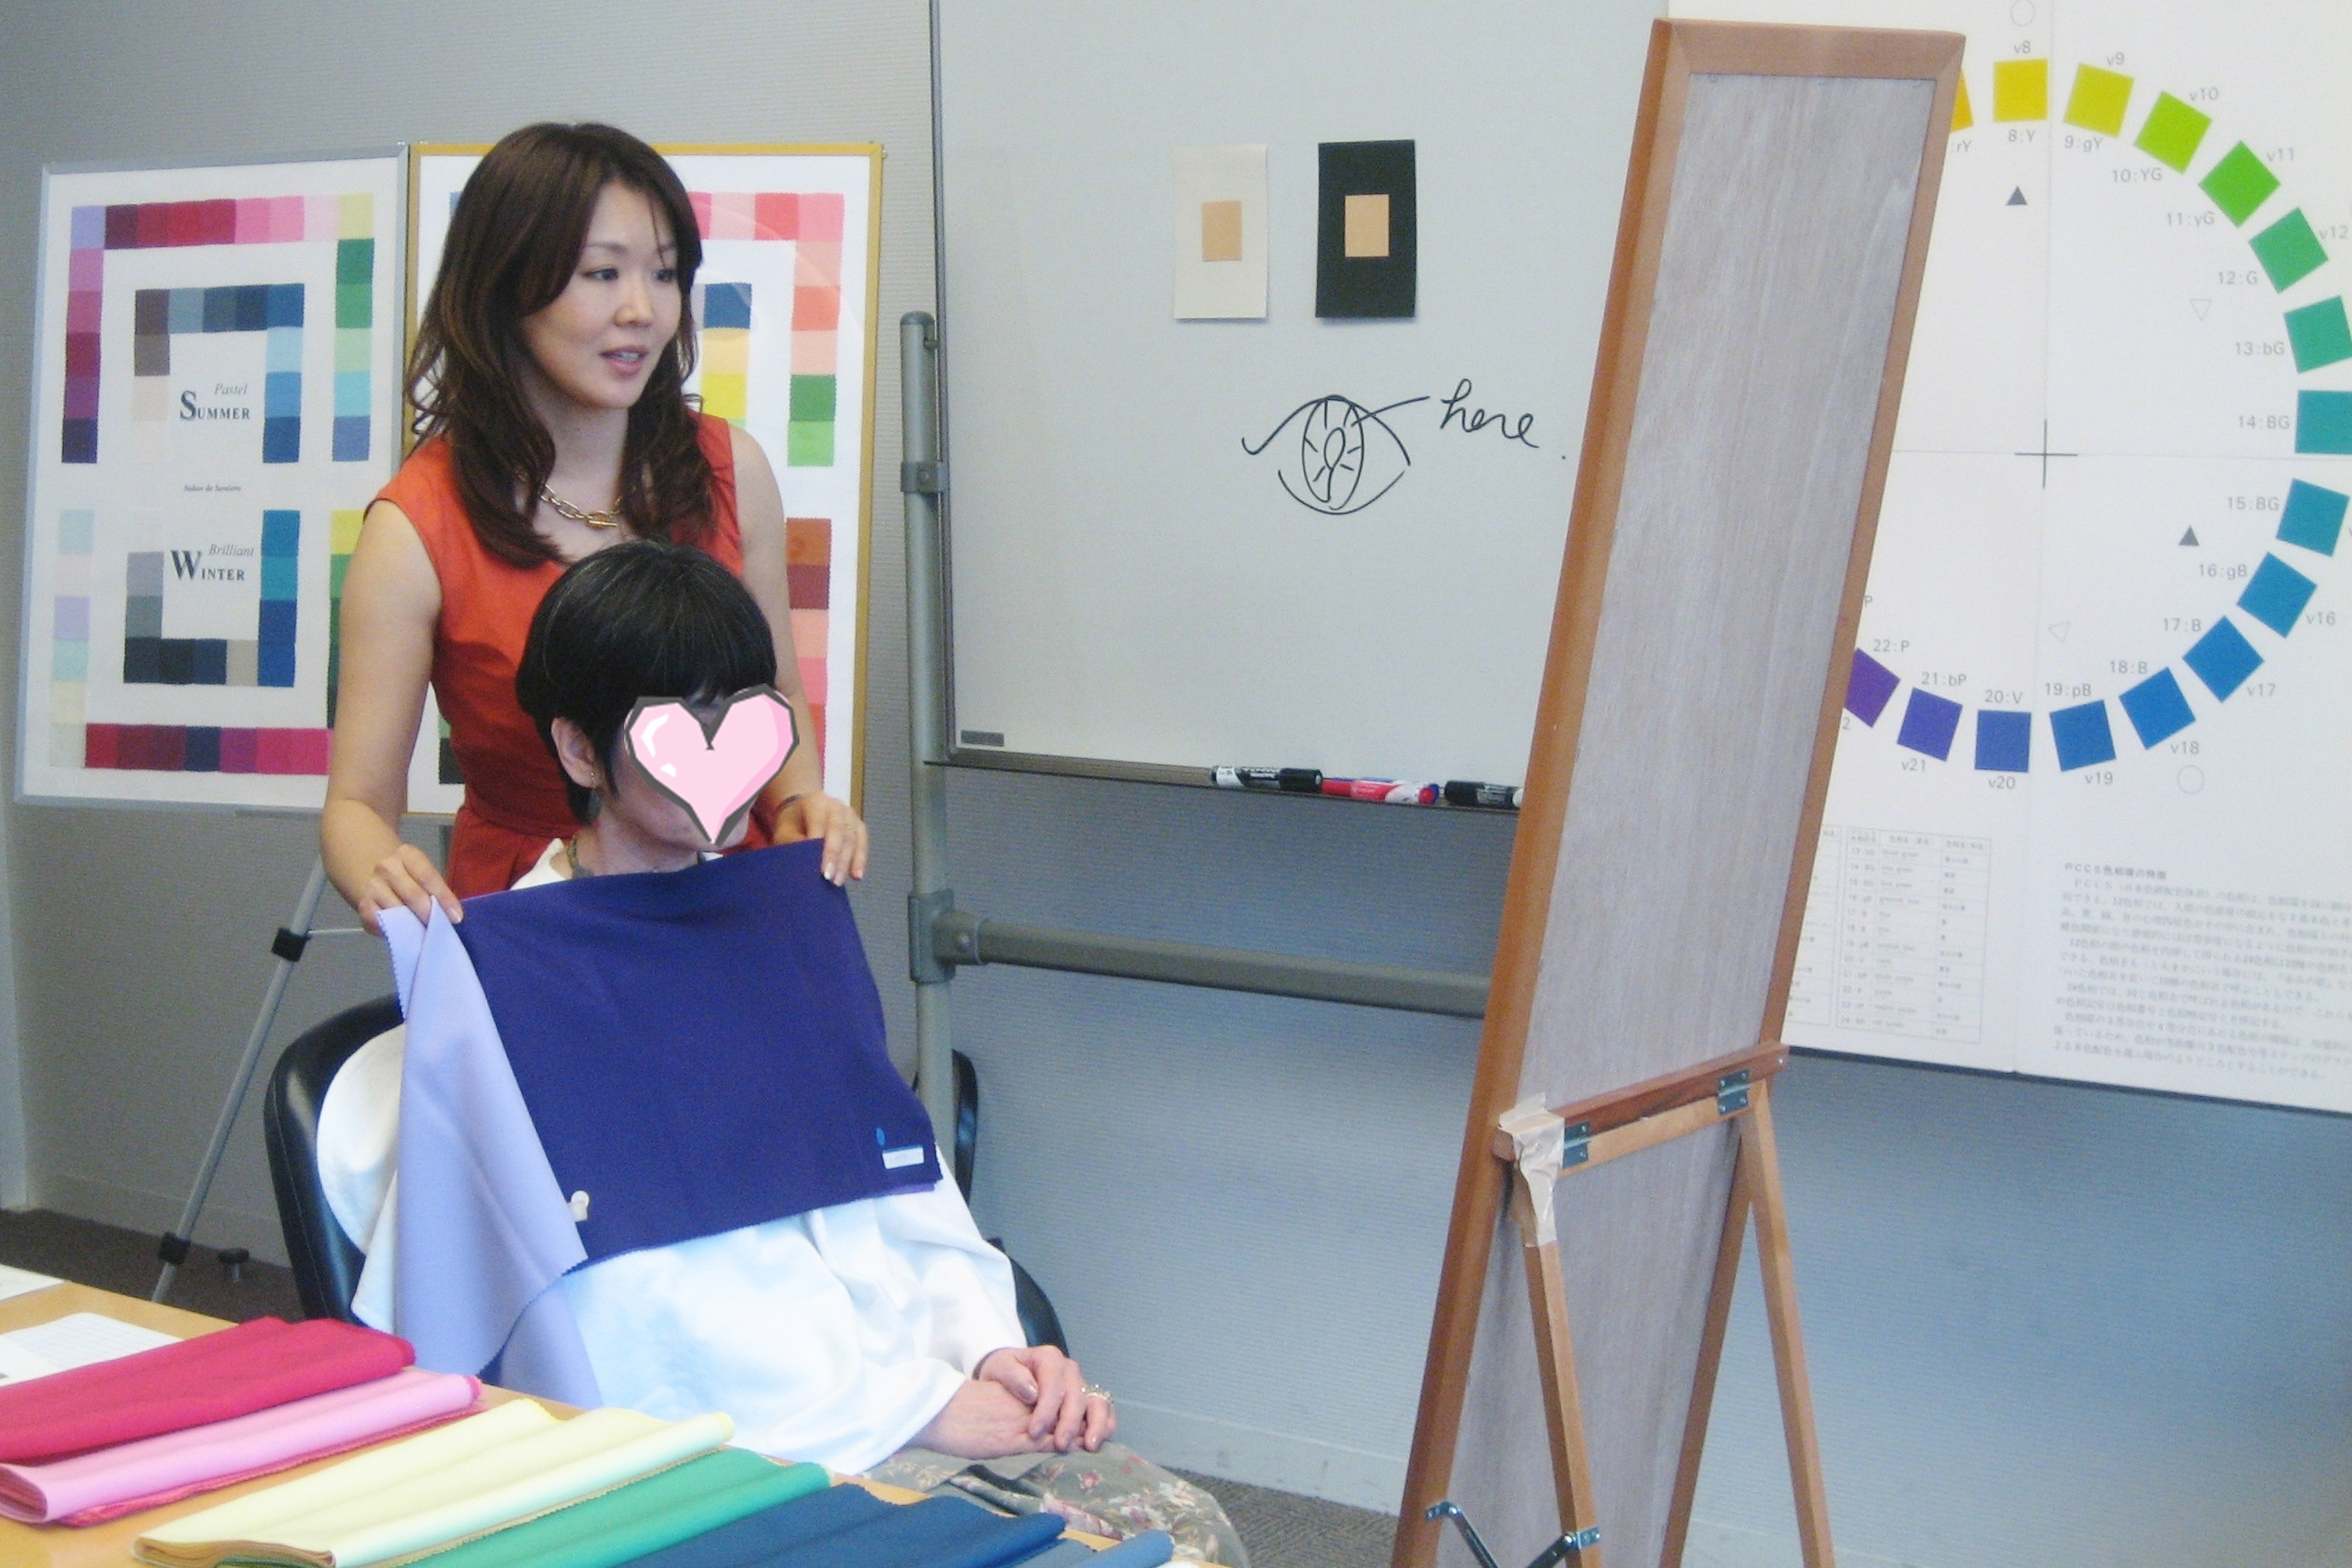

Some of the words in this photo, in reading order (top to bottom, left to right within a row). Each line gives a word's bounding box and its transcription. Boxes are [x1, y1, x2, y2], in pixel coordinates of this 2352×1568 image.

[2014, 41, 2031, 54] v8
[2106, 52, 2125, 66] v9
[2188, 87, 2219, 102] v10
[2008, 129, 2035, 142] 8:Y
[1950, 139, 1972, 153] :rY
[2064, 136, 2103, 152] 9:gY
[2266, 147, 2295, 163] v11
[2112, 168, 2162, 183] 10:YG
[2167, 211, 2214, 229] 11:yG
[2218, 271, 2258, 285] 12:G
[2235, 341, 2285, 355] 13:bG
[214, 383, 248, 394] Pastel
[180, 390, 250, 421] SUMMER
[2238, 415, 2290, 429] 14:BG
[2227, 496, 2279, 511] 15:BG
[209, 544, 255, 556] Brilliant
[171, 549, 245, 580] WINTER
[2199, 564, 2247, 580] 16:gB
[2163, 618, 2202, 632] 17:B
[2306, 612, 2336, 626] v16
[1873, 640, 1910, 652] 22:P
[2110, 661, 2148, 674] 18:B
[1922, 673, 1967, 686] 21:bP
[2045, 682, 2091, 698] 19:pB
[2247, 683, 2275, 697] v17
[1985, 690, 2023, 705] 20:V
[2171, 741, 2199, 755] v18
[1901, 758, 1927, 771] v21
[1989, 776, 2016, 790] v20
[2085, 771, 2113, 785] v19
